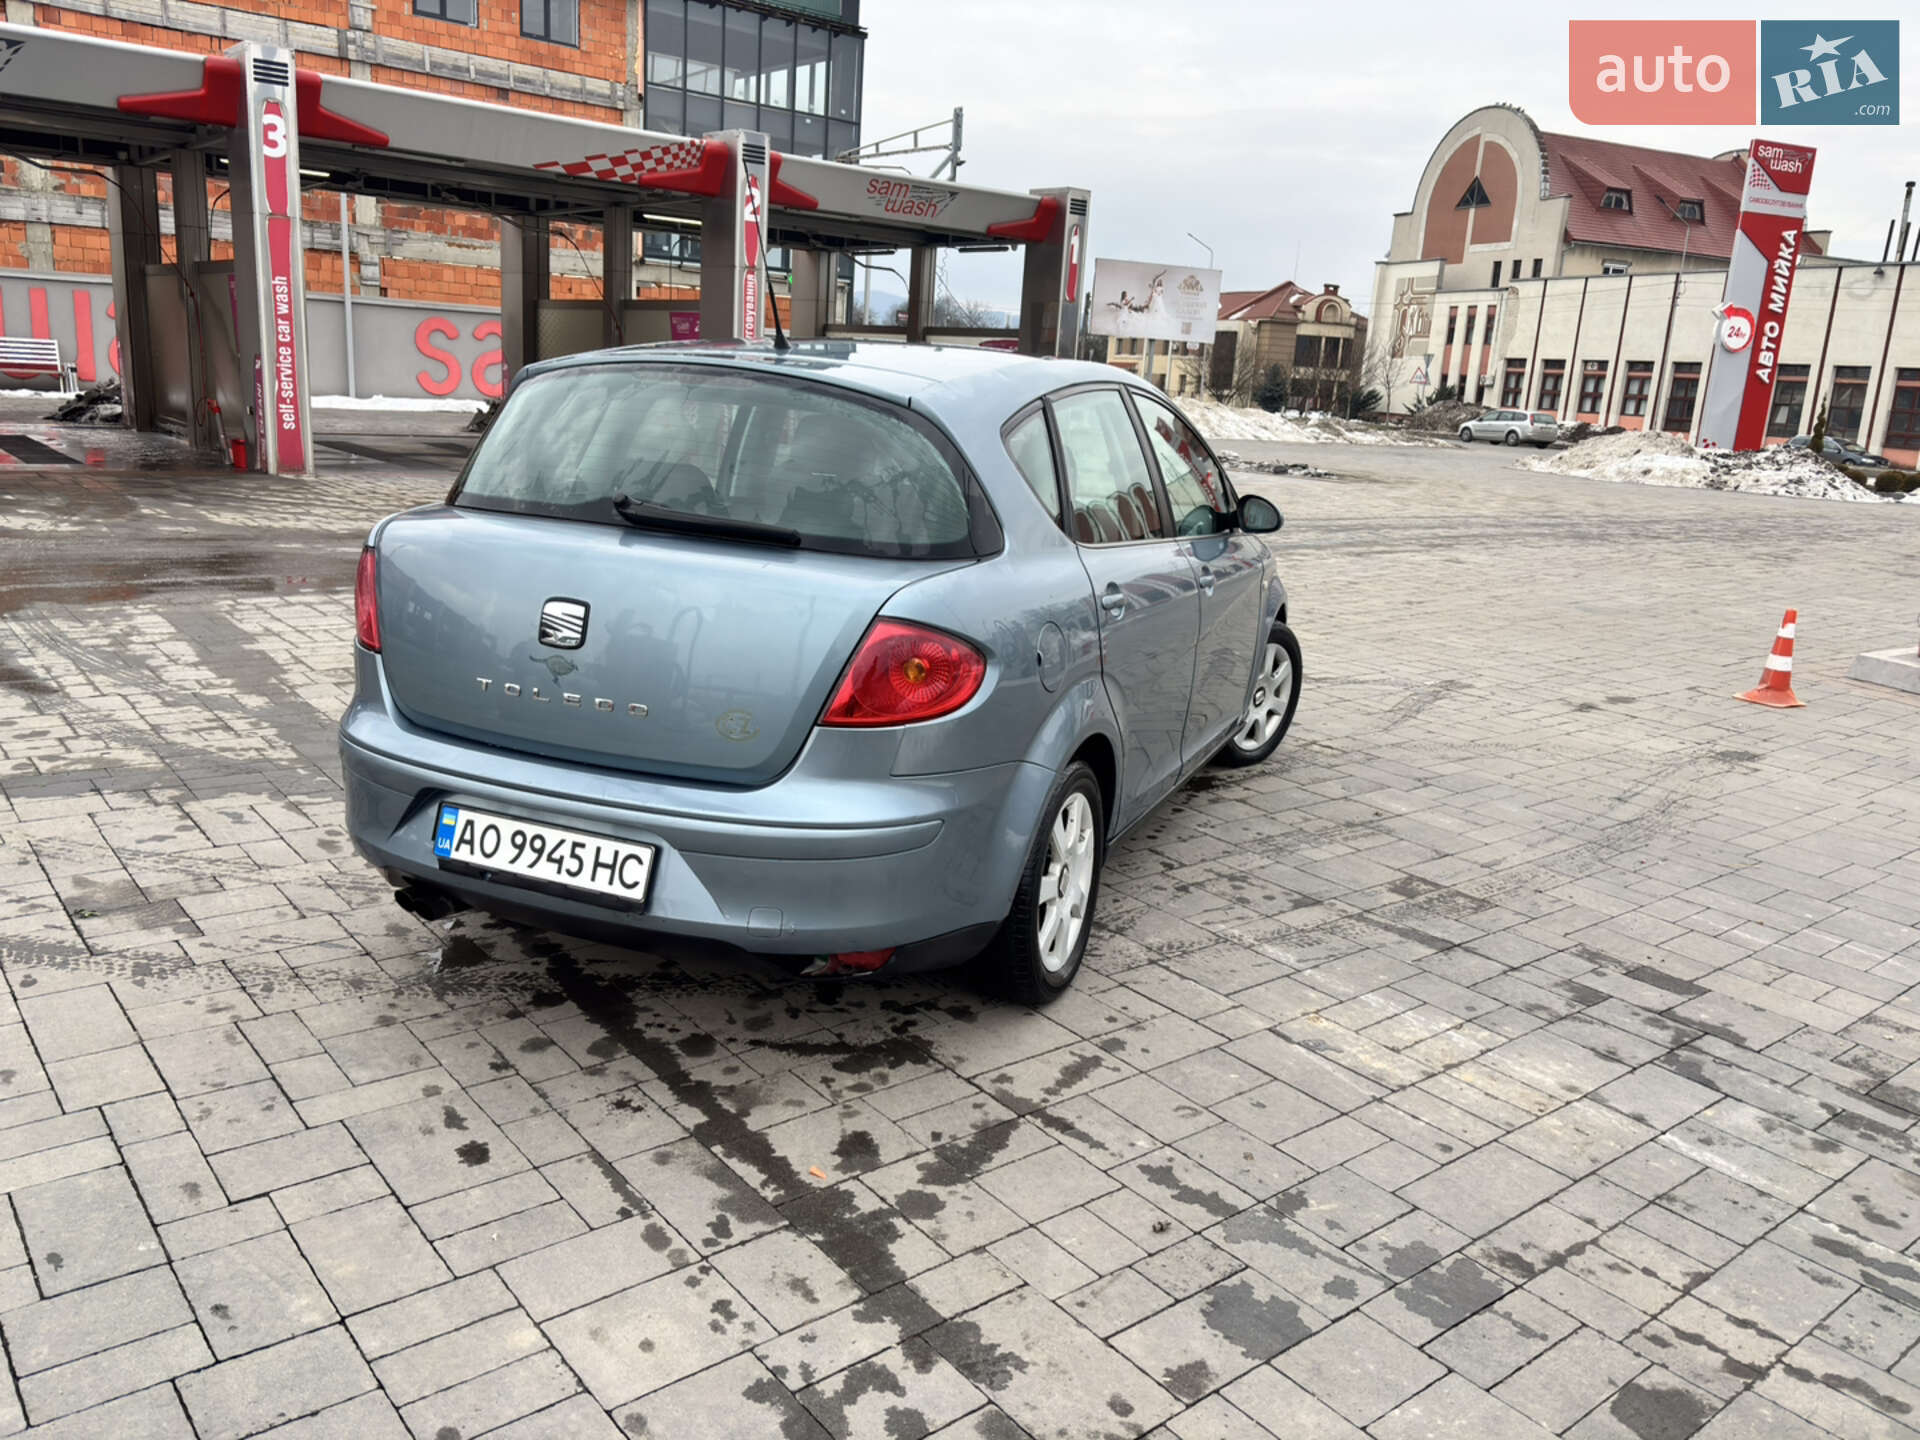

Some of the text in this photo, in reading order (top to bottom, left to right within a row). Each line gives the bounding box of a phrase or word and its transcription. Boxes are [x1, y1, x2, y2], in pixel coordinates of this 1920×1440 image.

[262, 114, 288, 158] 3
[1757, 145, 1784, 159] sam
[1770, 157, 1803, 174] wash
[744, 187, 761, 221] 2
[866, 178, 910, 198] sam
[884, 197, 938, 218] wash
[1756, 320, 1780, 384] АВТО
[1768, 229, 1798, 315] МИЙКА
[272, 275, 297, 431] self-service car wash
[476, 677, 648, 718] TOLEDO
[437, 837, 451, 850] UA
[454, 818, 645, 890] AO 9945 HC
